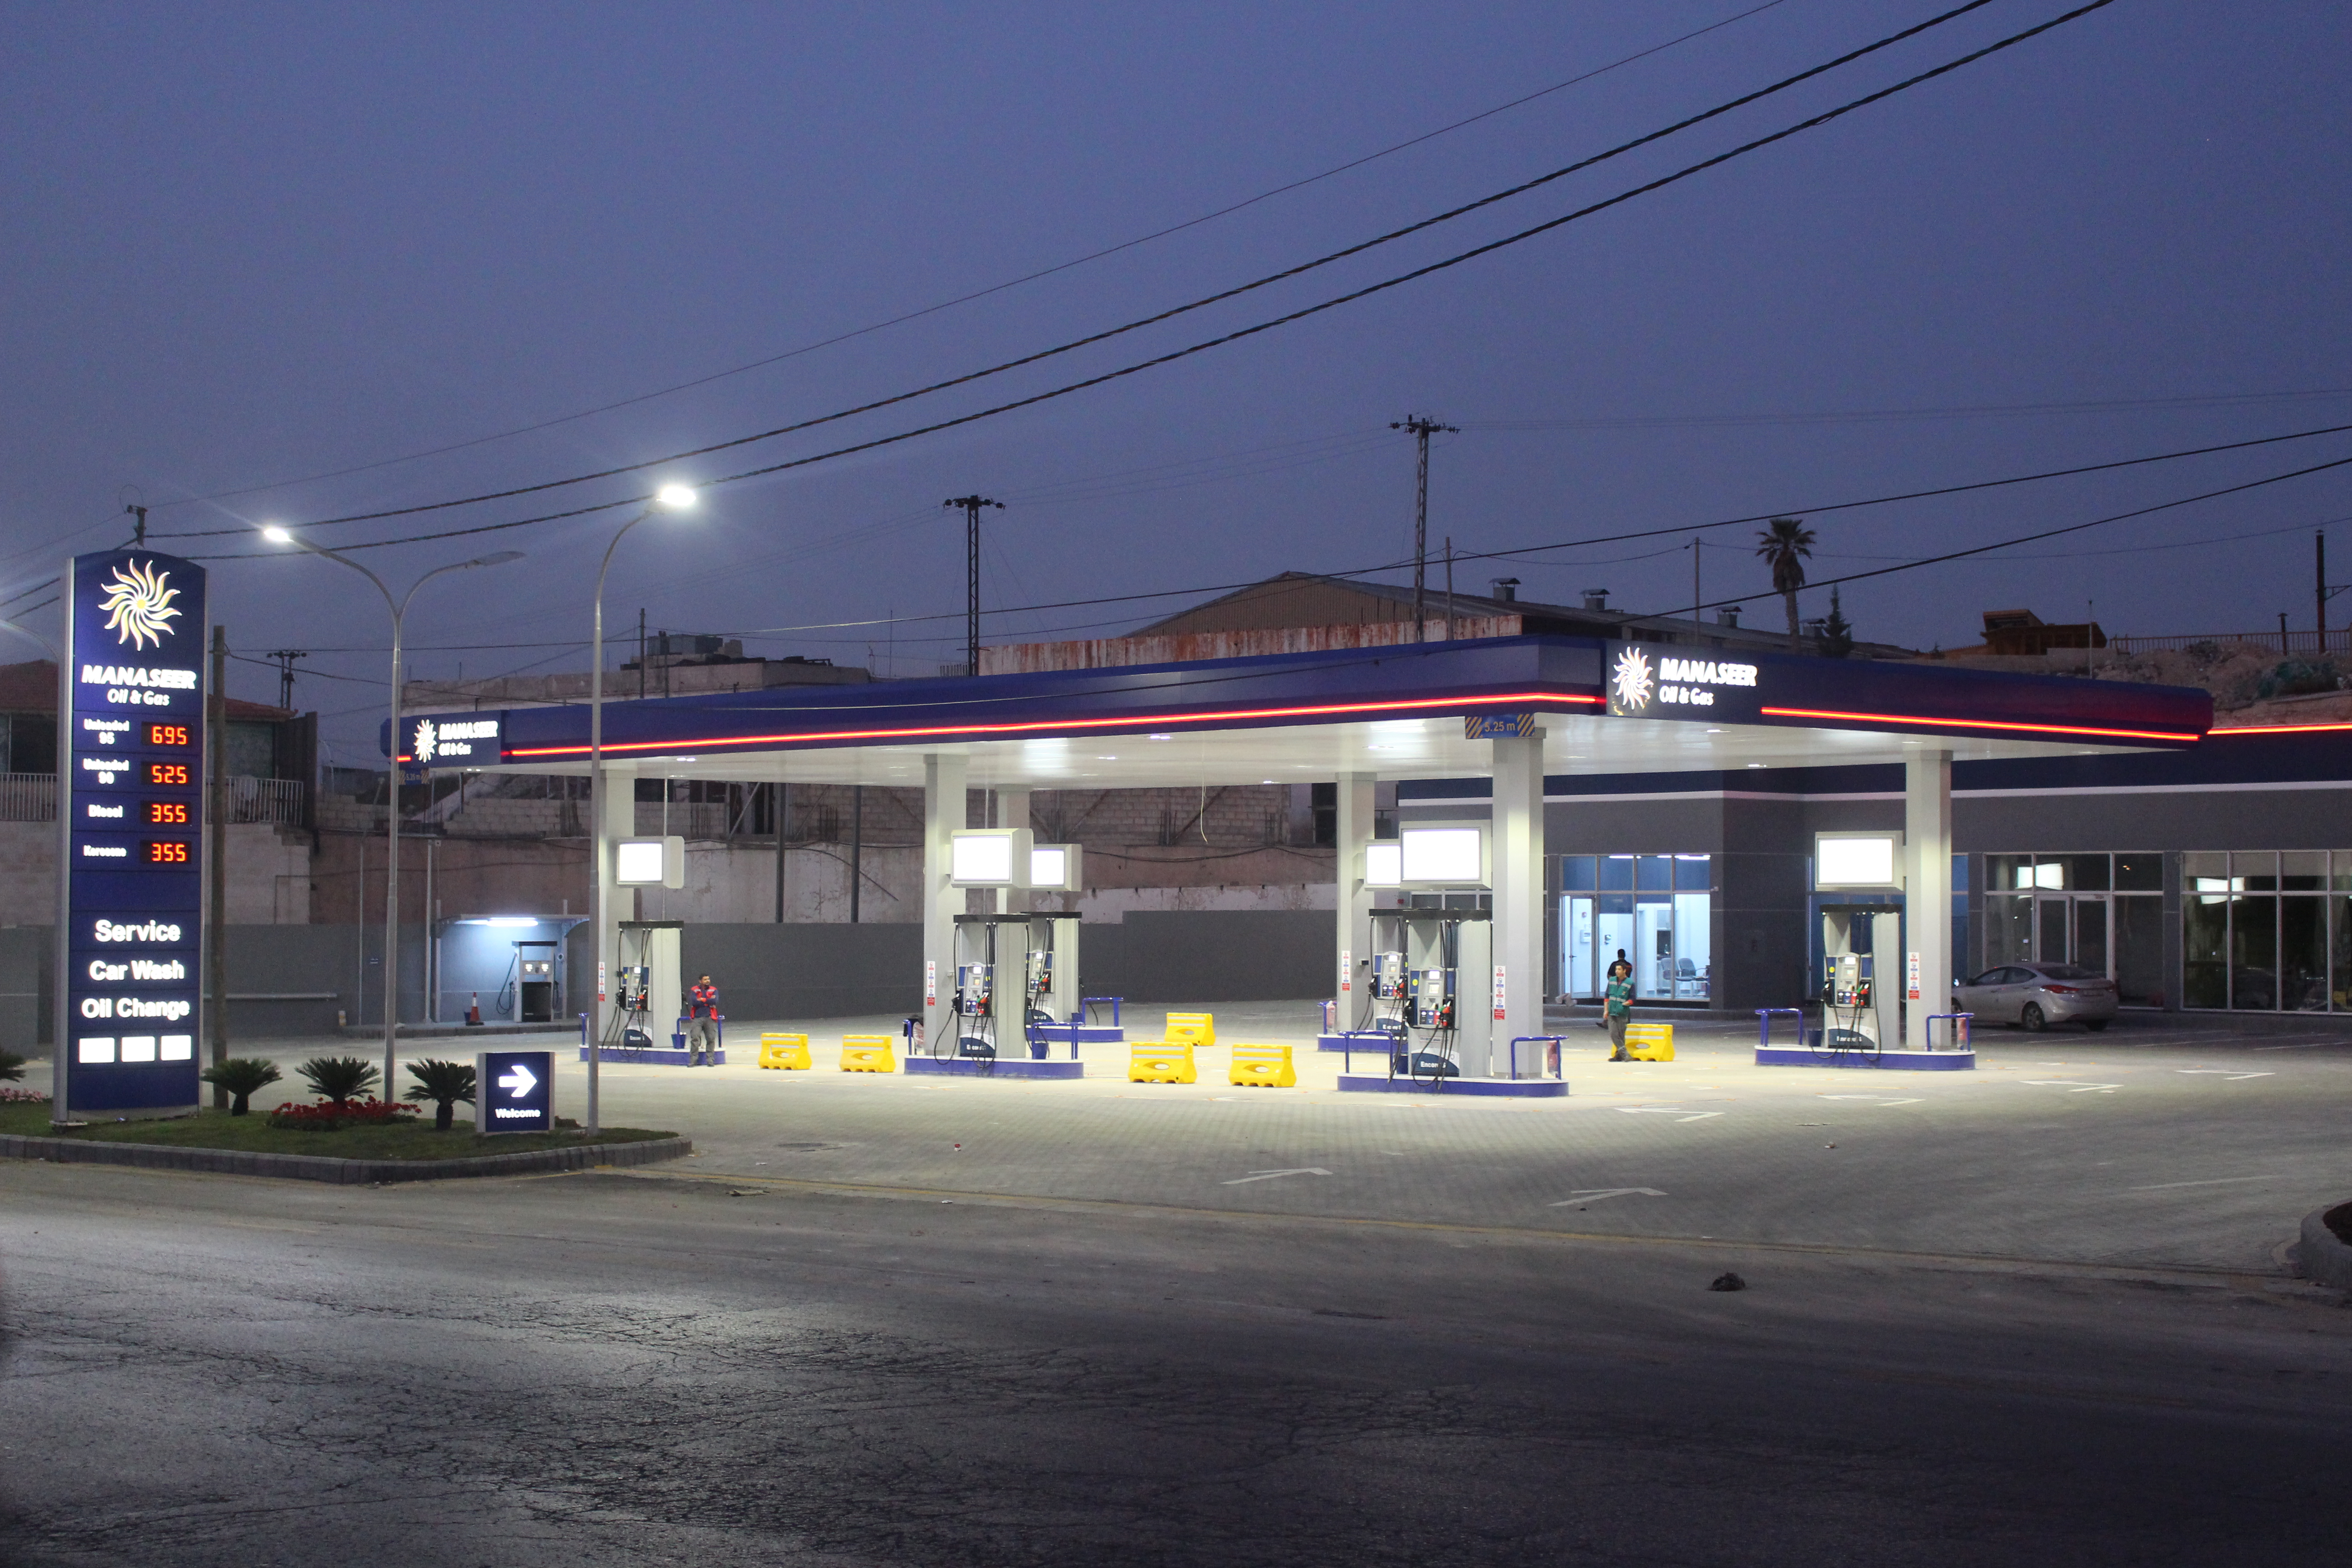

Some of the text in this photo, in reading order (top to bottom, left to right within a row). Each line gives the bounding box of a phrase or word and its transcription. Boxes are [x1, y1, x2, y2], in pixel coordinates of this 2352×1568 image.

[82, 665, 196, 689] MANASEER
[1659, 658, 1757, 686] MANASEER
[108, 688, 169, 706] Oil & Gas
[1659, 686, 1713, 706] Oil & Gas
[84, 719, 129, 731] Unleaded
[439, 721, 498, 740] MANASEER
[1485, 721, 1515, 732] 5.25 m
[99, 732, 114, 744] 95
[152, 725, 187, 745] 695
[98, 771, 114, 784] 90
[152, 765, 187, 783] 525
[88, 804, 122, 818] Diesel
[152, 804, 186, 822] 355
[84, 845, 126, 857] Kerosene
[152, 843, 186, 861] 355
[95, 920, 181, 942] Service
[90, 960, 184, 980] Car Wash
[82, 998, 190, 1020] Oil Change
[495, 1108, 540, 1118] Welcome
